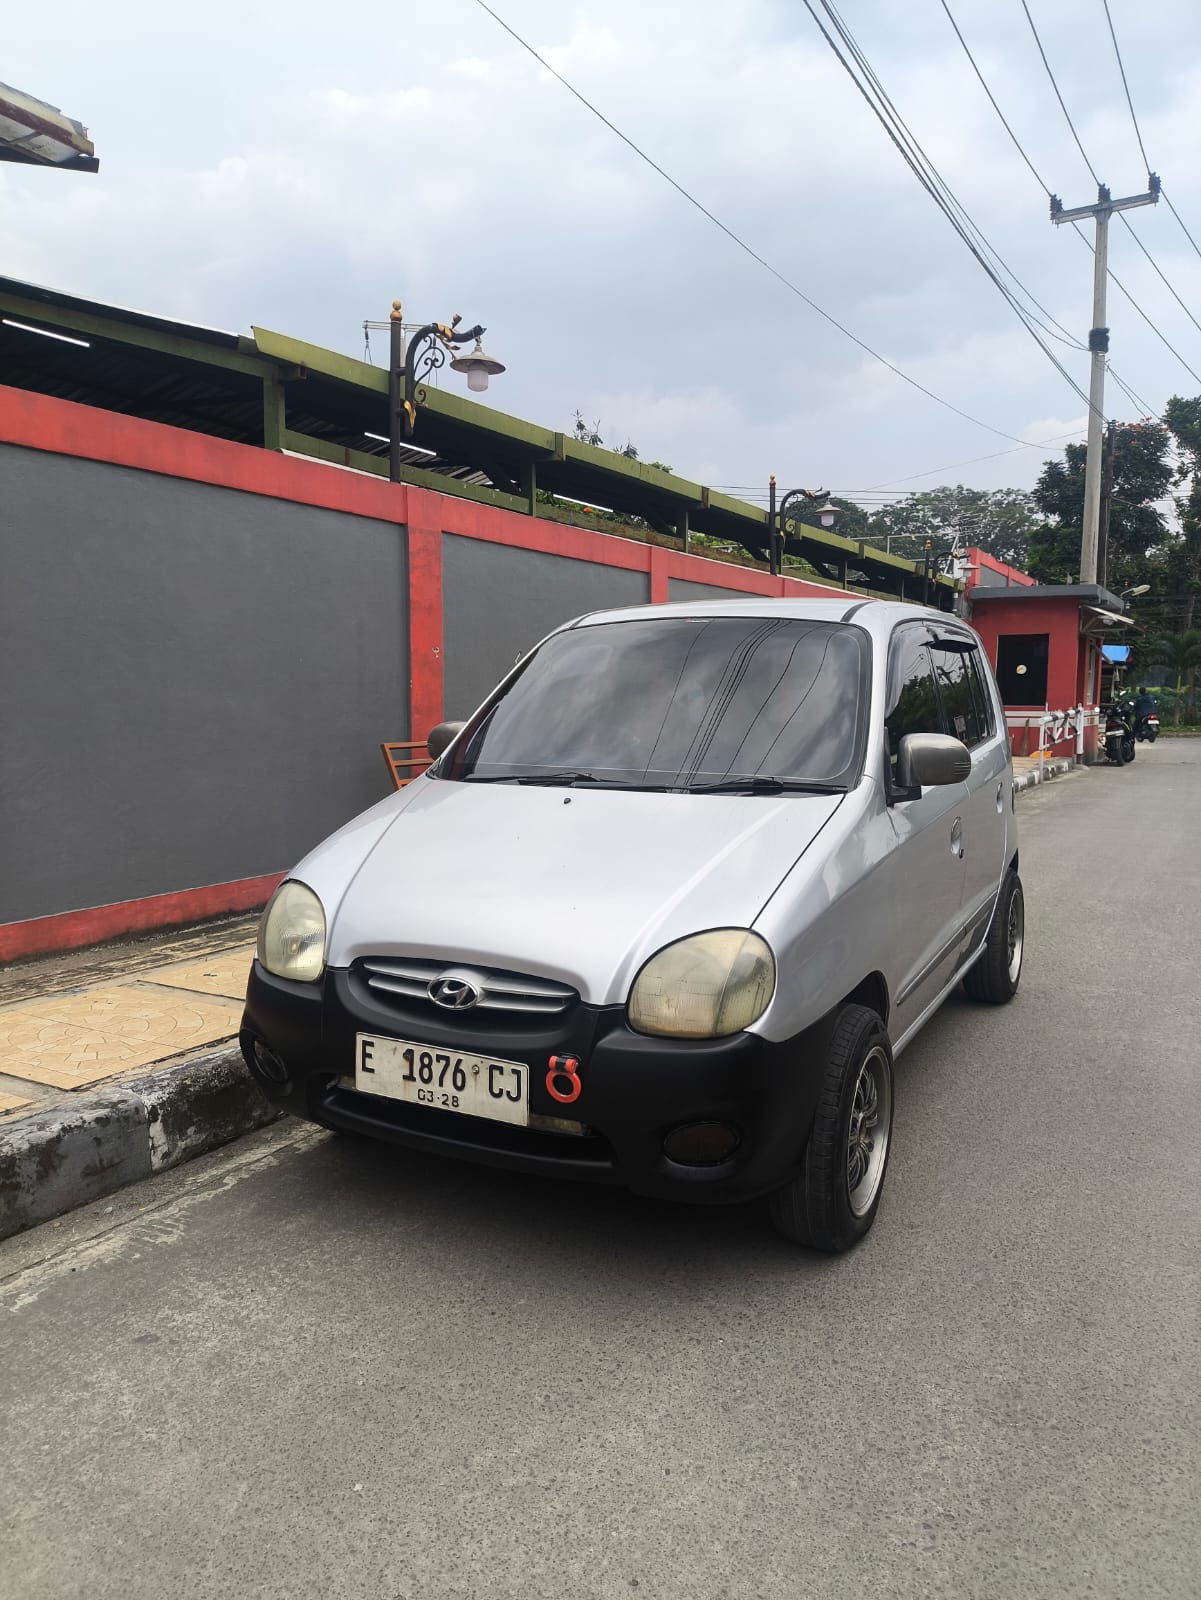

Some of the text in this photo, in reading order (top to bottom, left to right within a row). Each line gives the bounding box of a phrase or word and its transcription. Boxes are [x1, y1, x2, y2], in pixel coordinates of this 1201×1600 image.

[361, 1039, 522, 1102] E 1876 CJ
